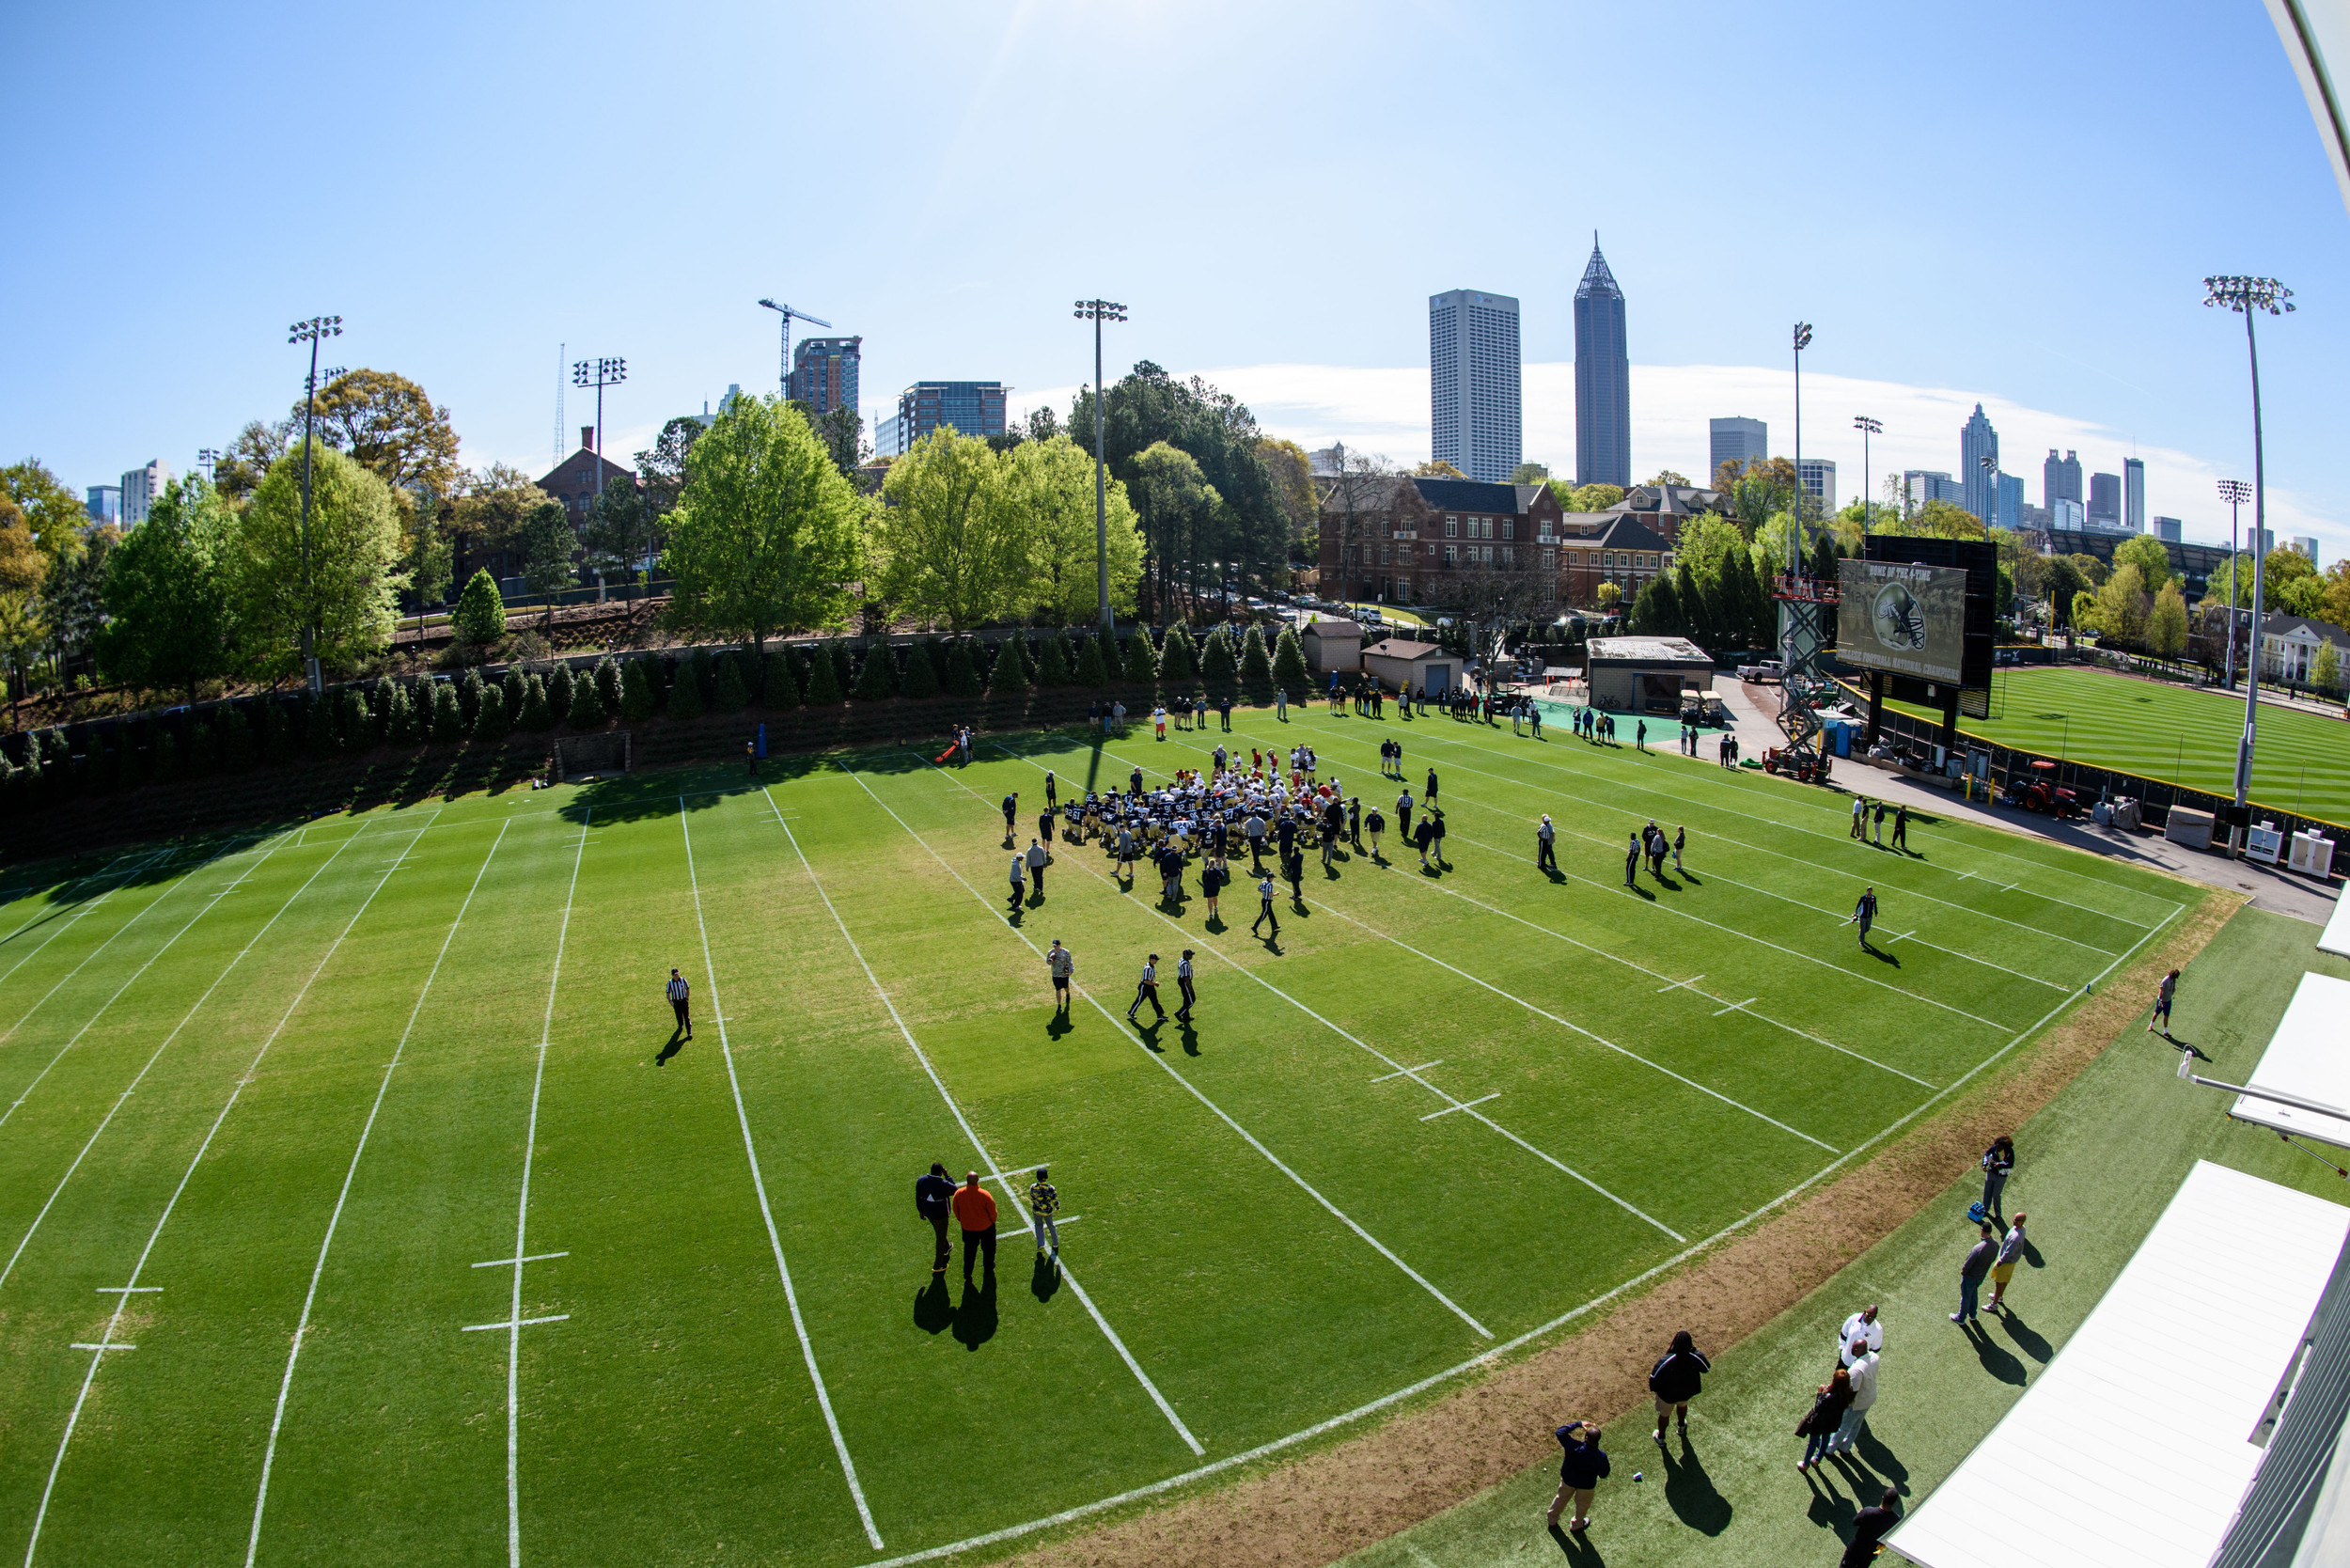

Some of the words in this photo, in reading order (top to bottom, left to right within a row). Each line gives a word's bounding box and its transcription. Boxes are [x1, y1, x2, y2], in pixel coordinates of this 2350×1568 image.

[1869, 565, 1887, 578] HOME
[1887, 568, 1896, 579] OF
[1895, 568, 1909, 581] THE
[1909, 570, 1932, 584] 4-TIME
[1838, 648, 1863, 661] COLLEGE
[1862, 651, 1891, 667] FOOTBALL
[1892, 657, 1922, 674] NATIONAL
[1923, 664, 1960, 682] CHAMPIONS
[1175, 804, 1185, 813] 92
[1073, 810, 1080, 820] 61
[1224, 810, 1233, 821] 27
[1206, 831, 1212, 839] 2
